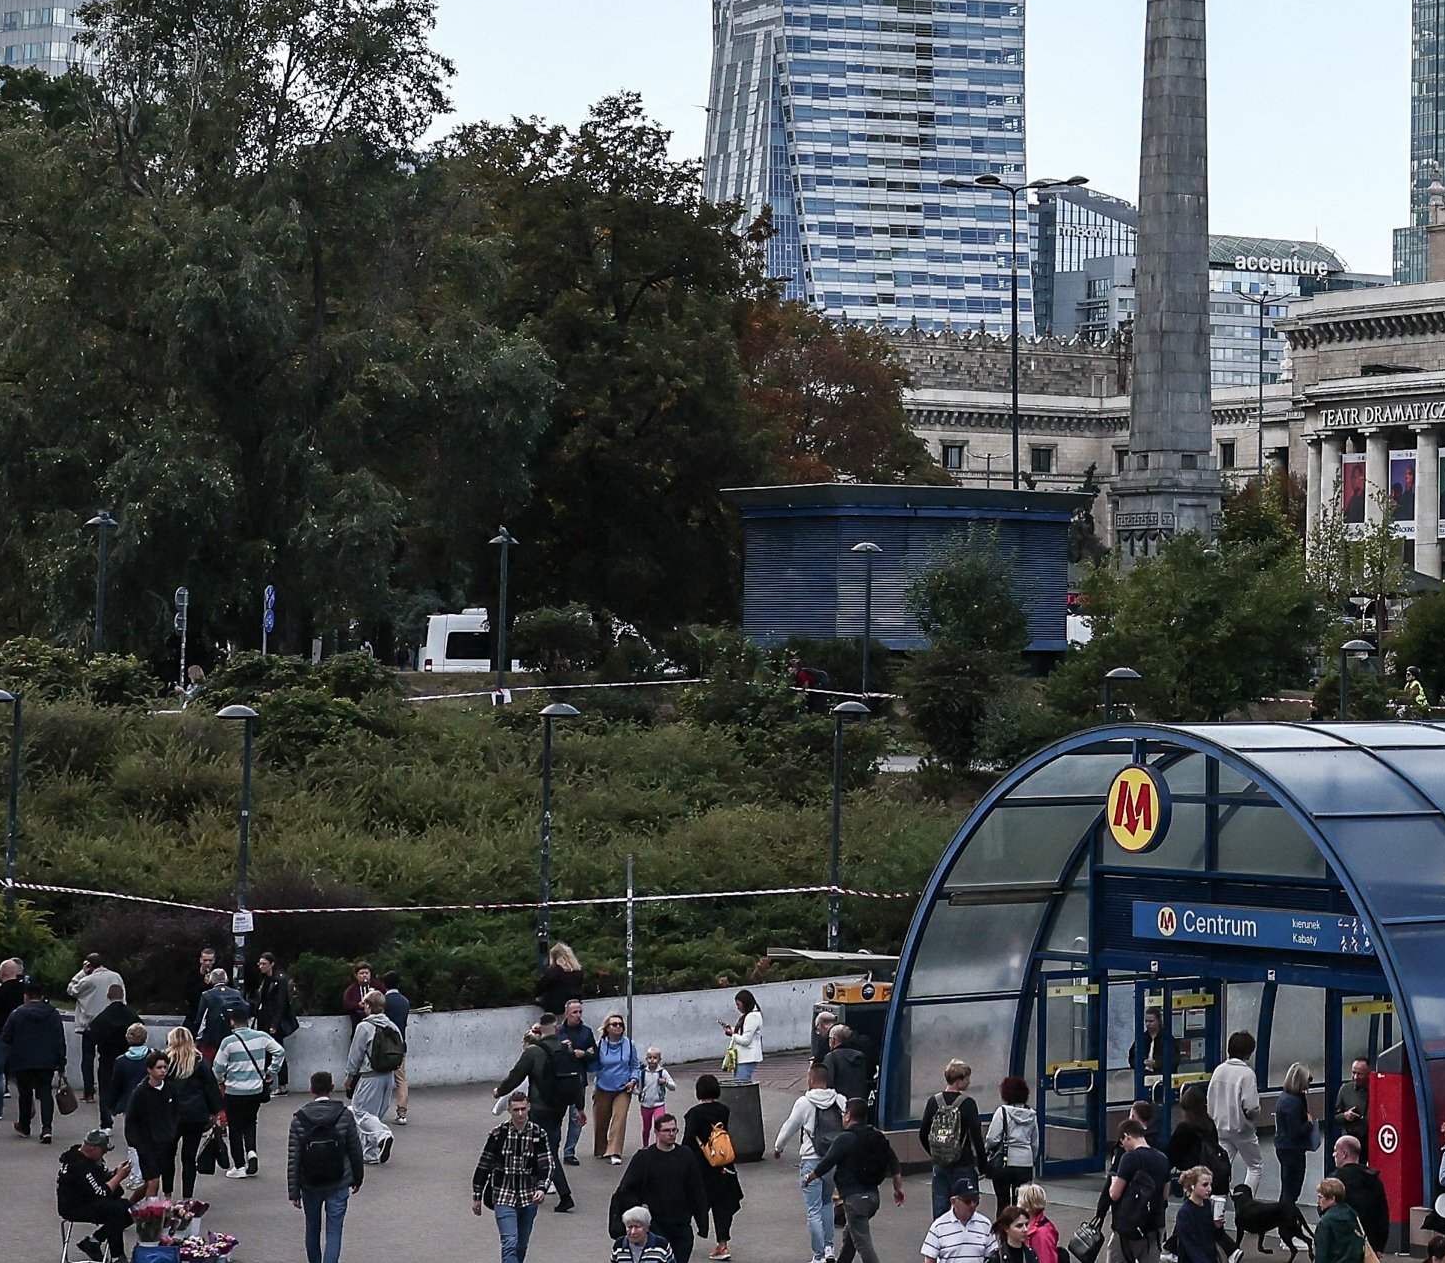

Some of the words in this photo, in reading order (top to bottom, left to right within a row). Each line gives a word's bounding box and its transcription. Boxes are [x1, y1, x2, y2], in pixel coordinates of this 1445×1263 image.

[1235, 256, 1328, 276] accenture
[1321, 408, 1360, 426] TEATR
[1113, 780, 1153, 836] M
[1183, 910, 1257, 937] Centrum
[1292, 919, 1321, 930] kierunek
[1292, 933, 1317, 946] Kabaty
